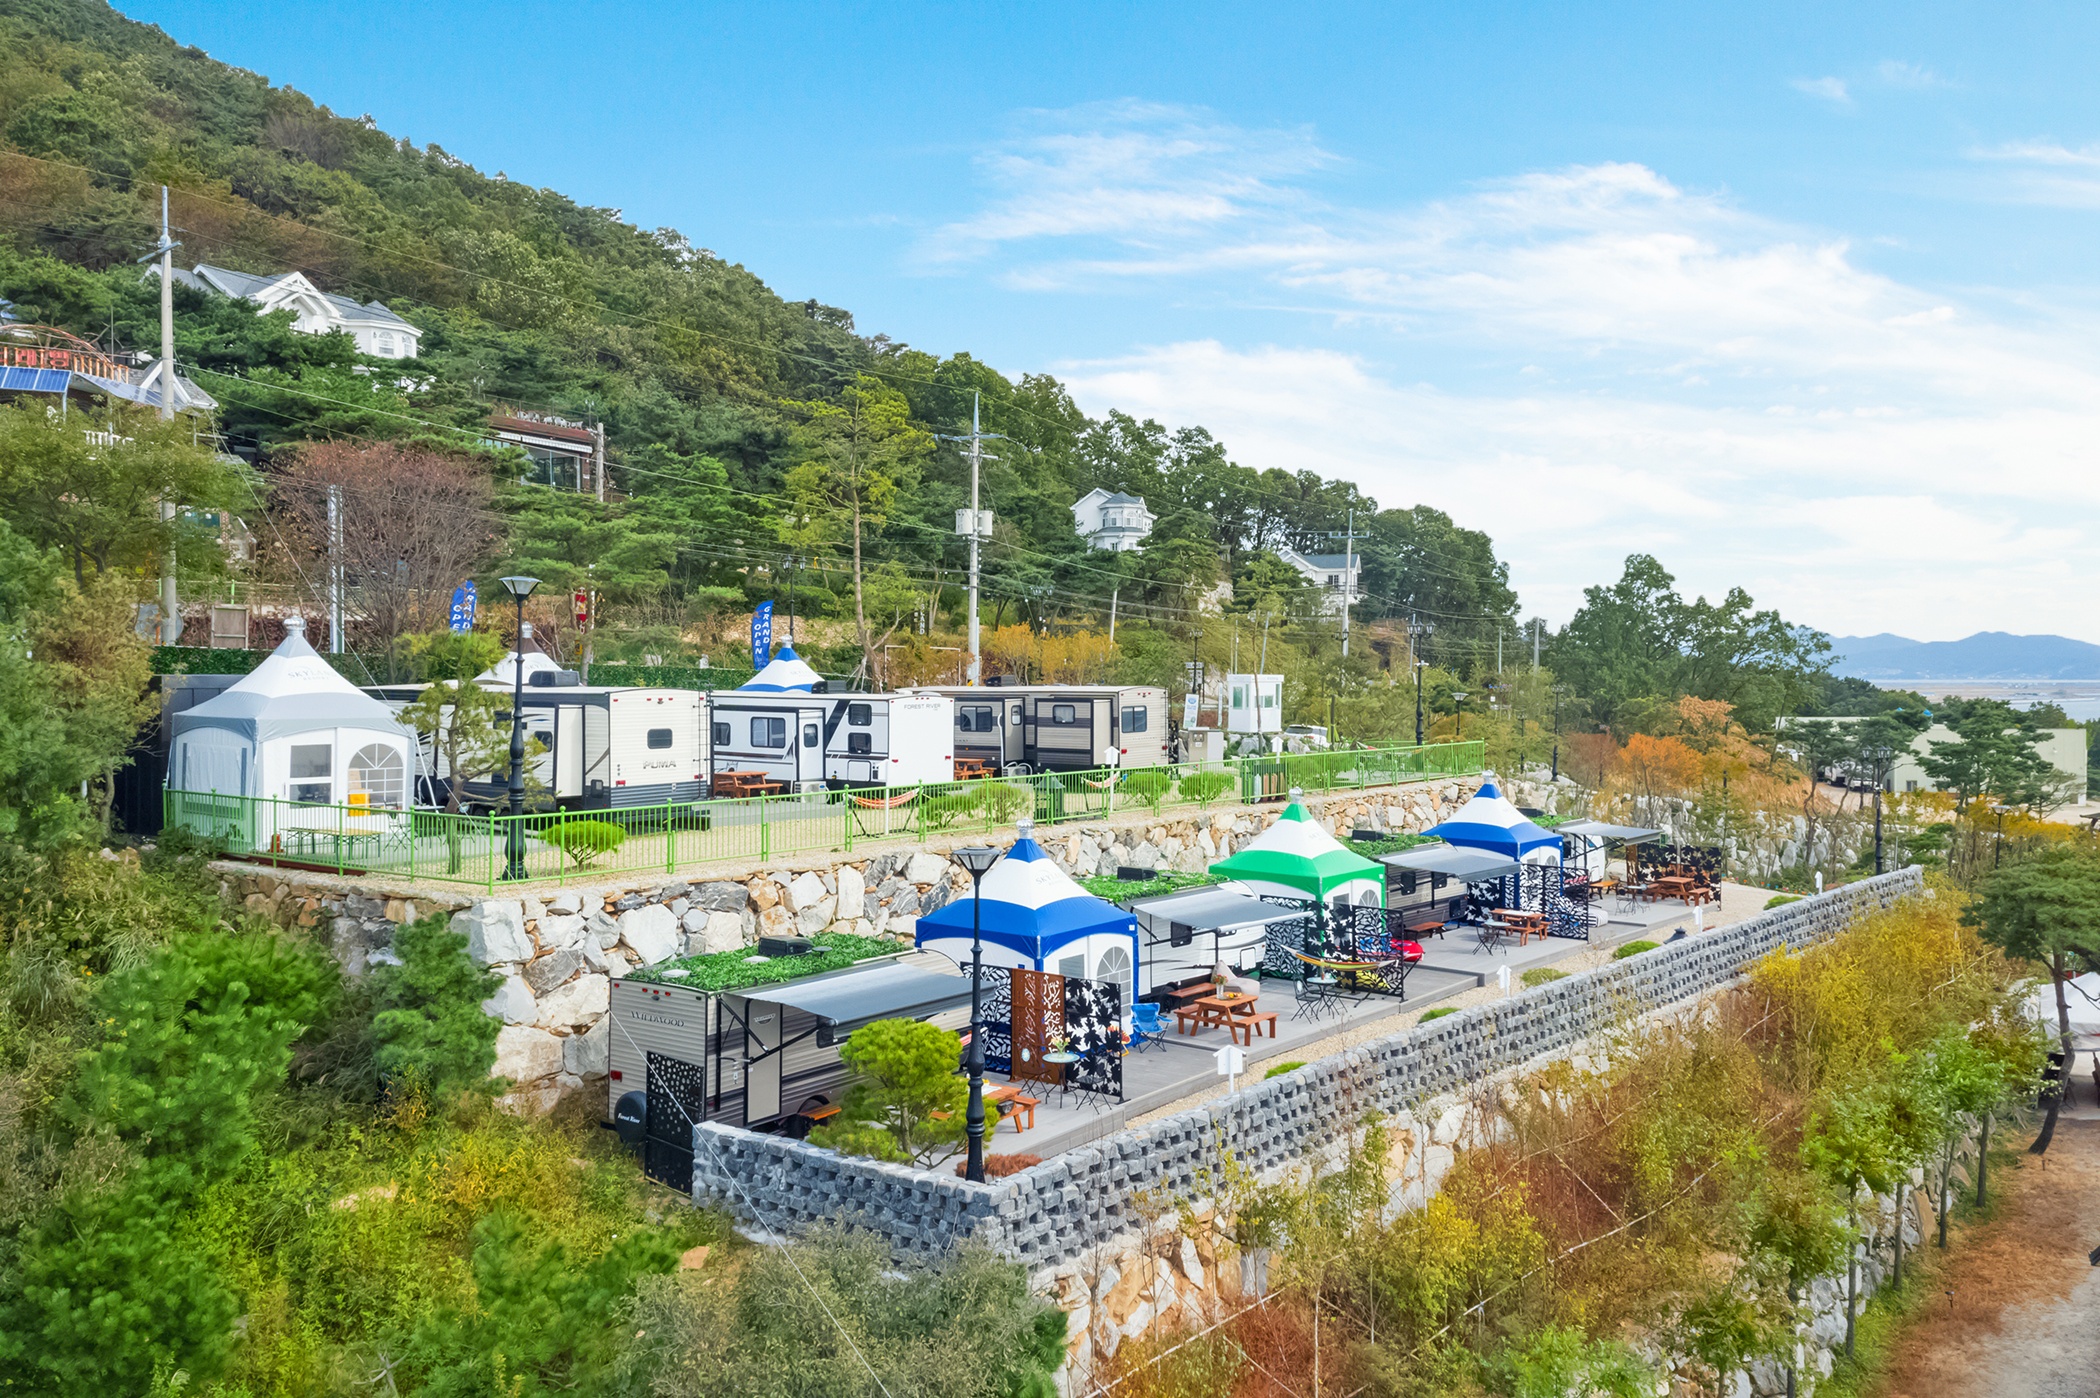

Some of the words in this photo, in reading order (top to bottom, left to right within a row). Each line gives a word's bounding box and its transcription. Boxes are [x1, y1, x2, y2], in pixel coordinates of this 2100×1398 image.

[453, 605, 462, 629] OPE
[762, 606, 771, 644] GRAND
[754, 624, 762, 655] OPEN
[643, 760, 677, 769] PUMA
[631, 1010, 685, 1027] WILDWOOD
